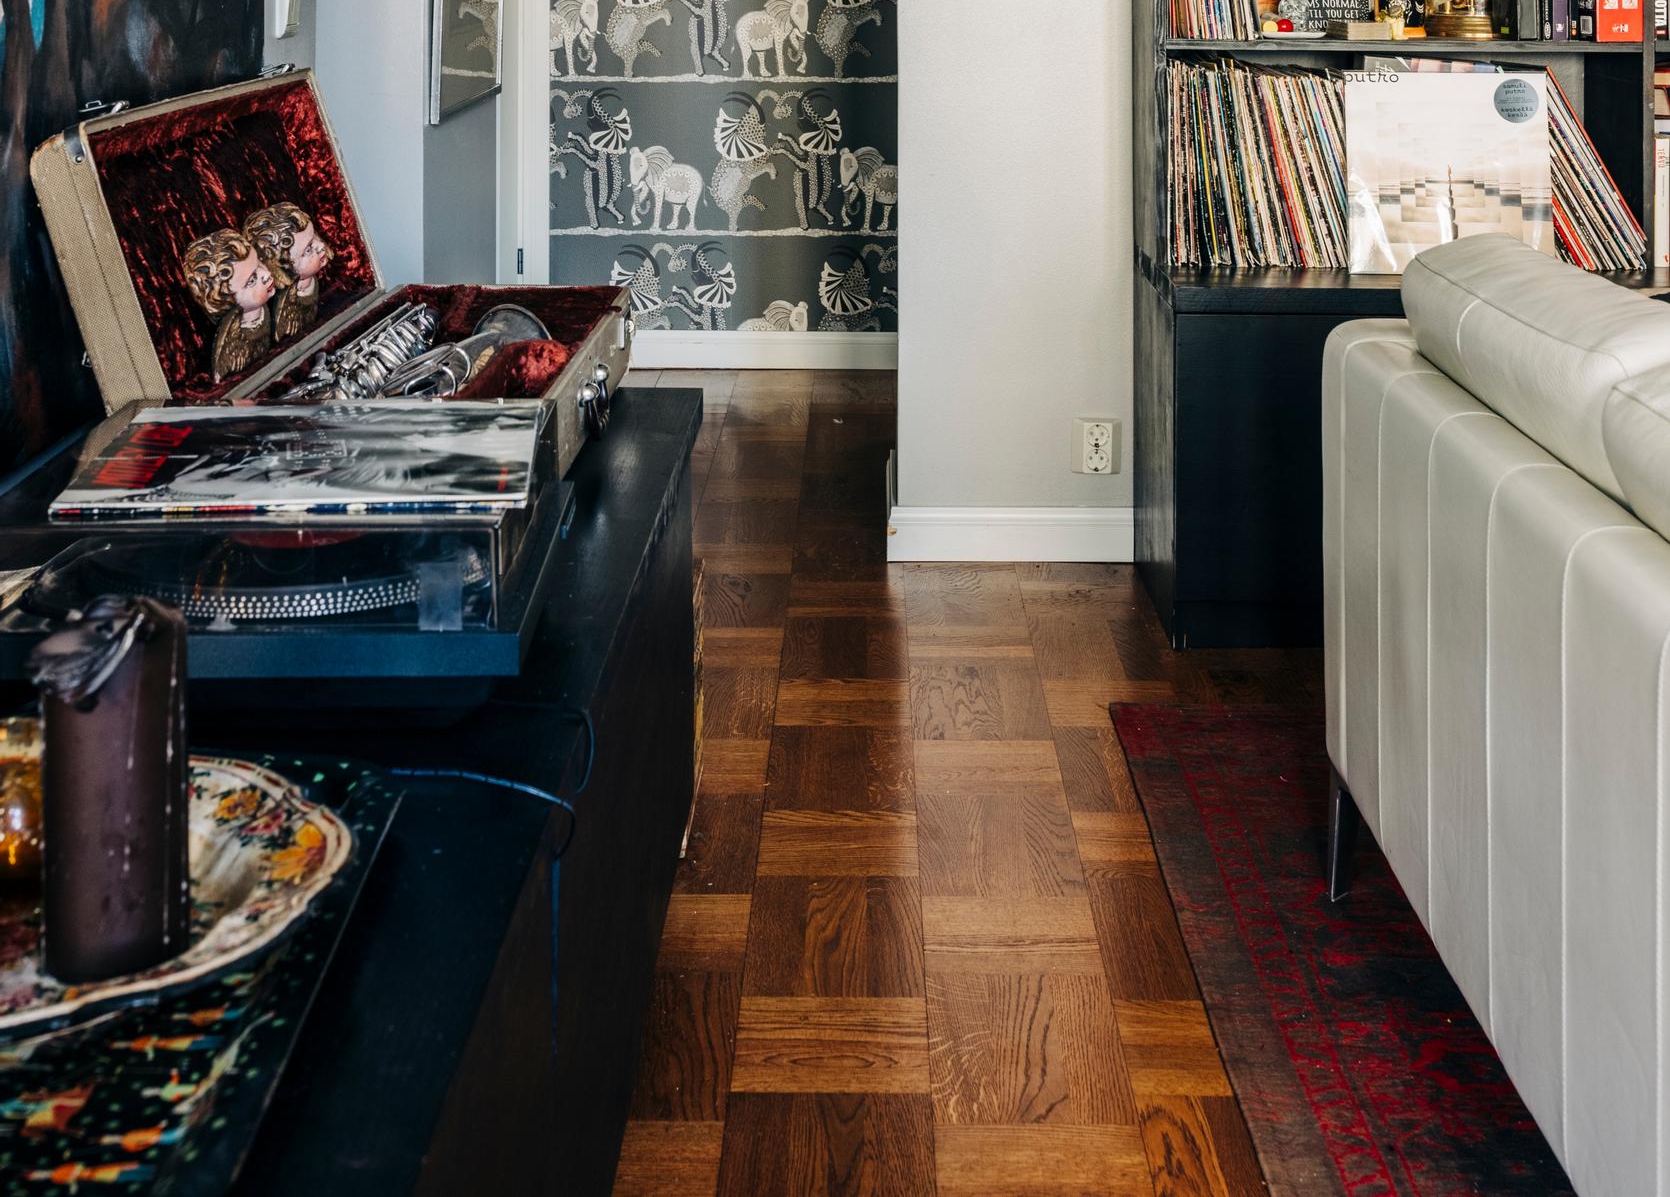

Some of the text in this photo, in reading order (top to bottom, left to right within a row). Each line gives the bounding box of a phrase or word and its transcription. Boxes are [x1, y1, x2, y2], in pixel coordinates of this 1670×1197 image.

[1322, 0, 1360, 9] NORMAL
[1325, 9, 1343, 18] YOU
[1344, 9, 1359, 18] GET
[1308, 19, 1329, 29] KNO
